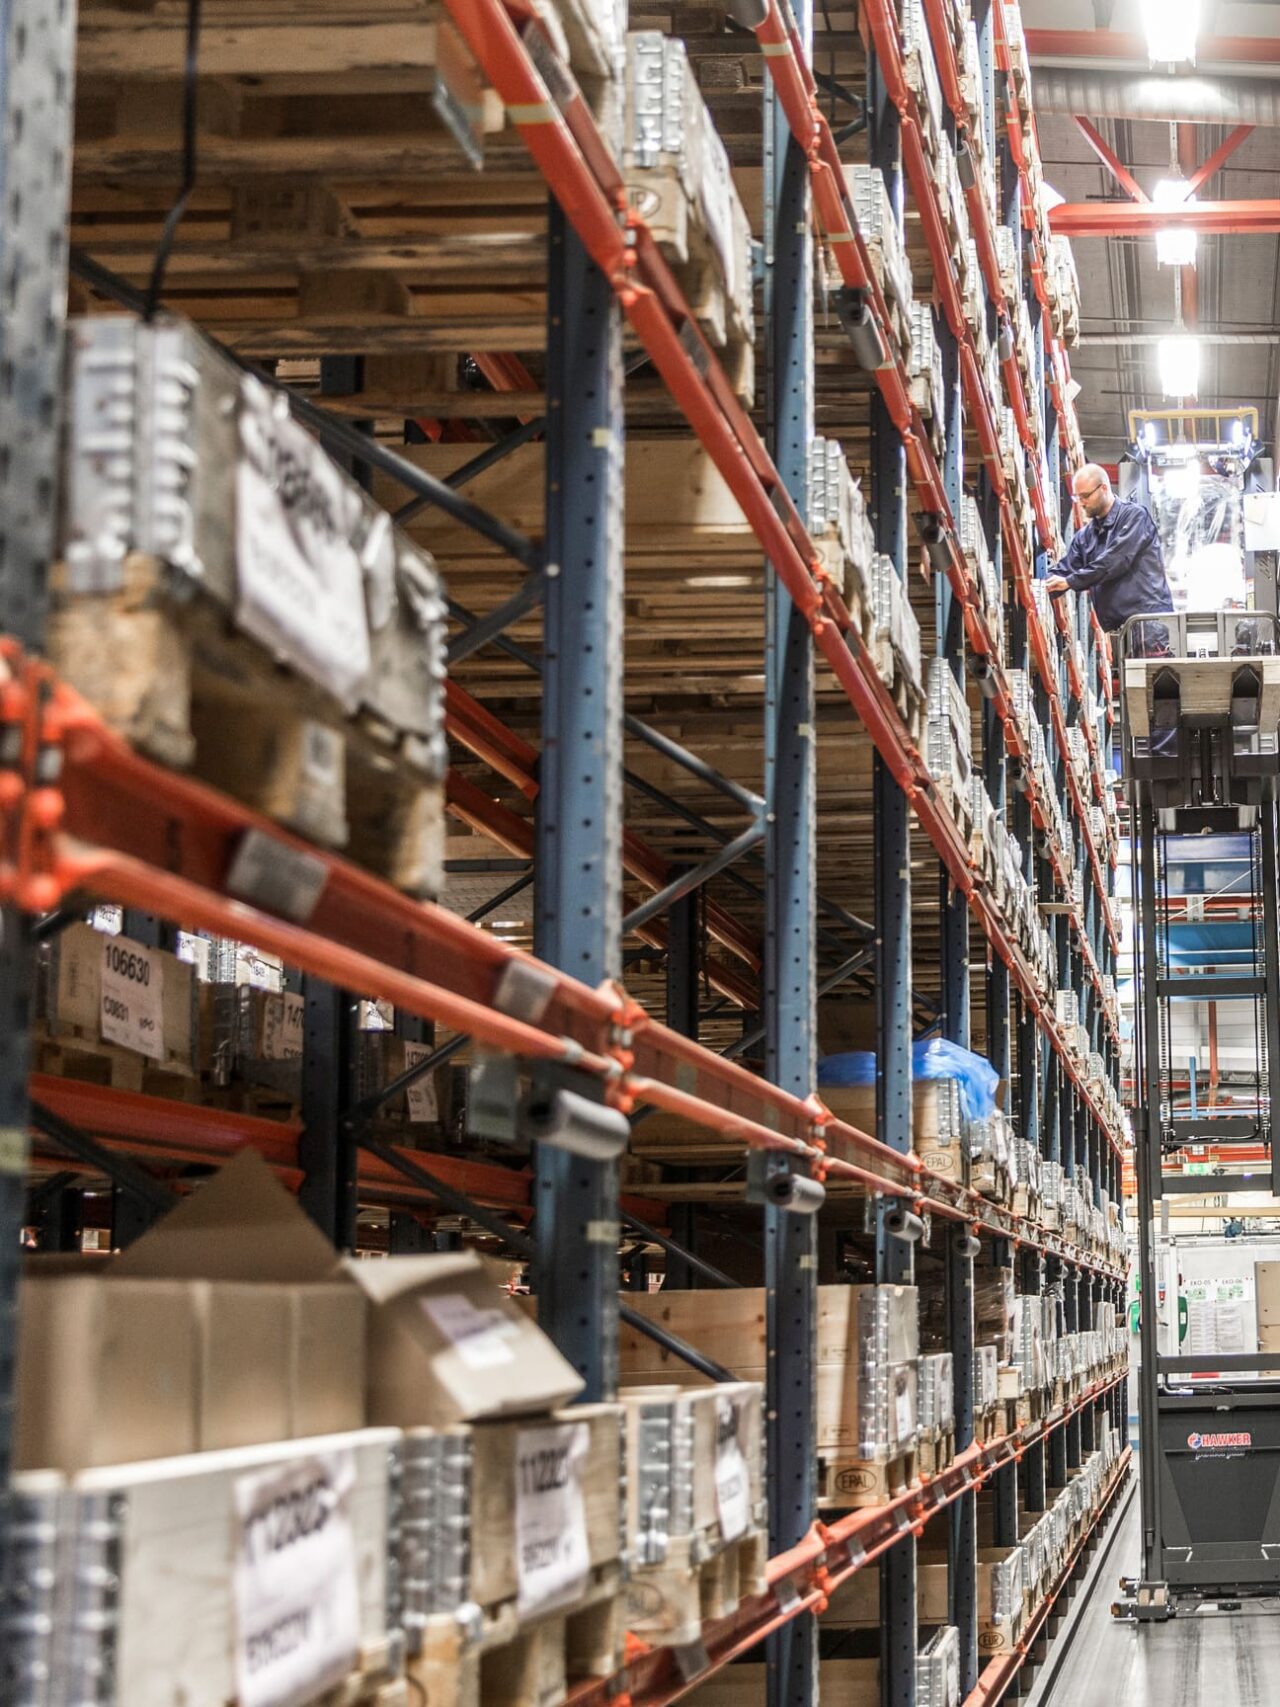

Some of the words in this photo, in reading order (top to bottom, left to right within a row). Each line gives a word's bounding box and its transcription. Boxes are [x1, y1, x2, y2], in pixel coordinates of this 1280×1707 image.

[105, 944, 151, 987] 106630
[926, 1156, 949, 1169] EPAL
[1201, 1432, 1251, 1447] HAWKER
[841, 1474, 870, 1489] EPAL
[983, 1634, 998, 1646] EUR
